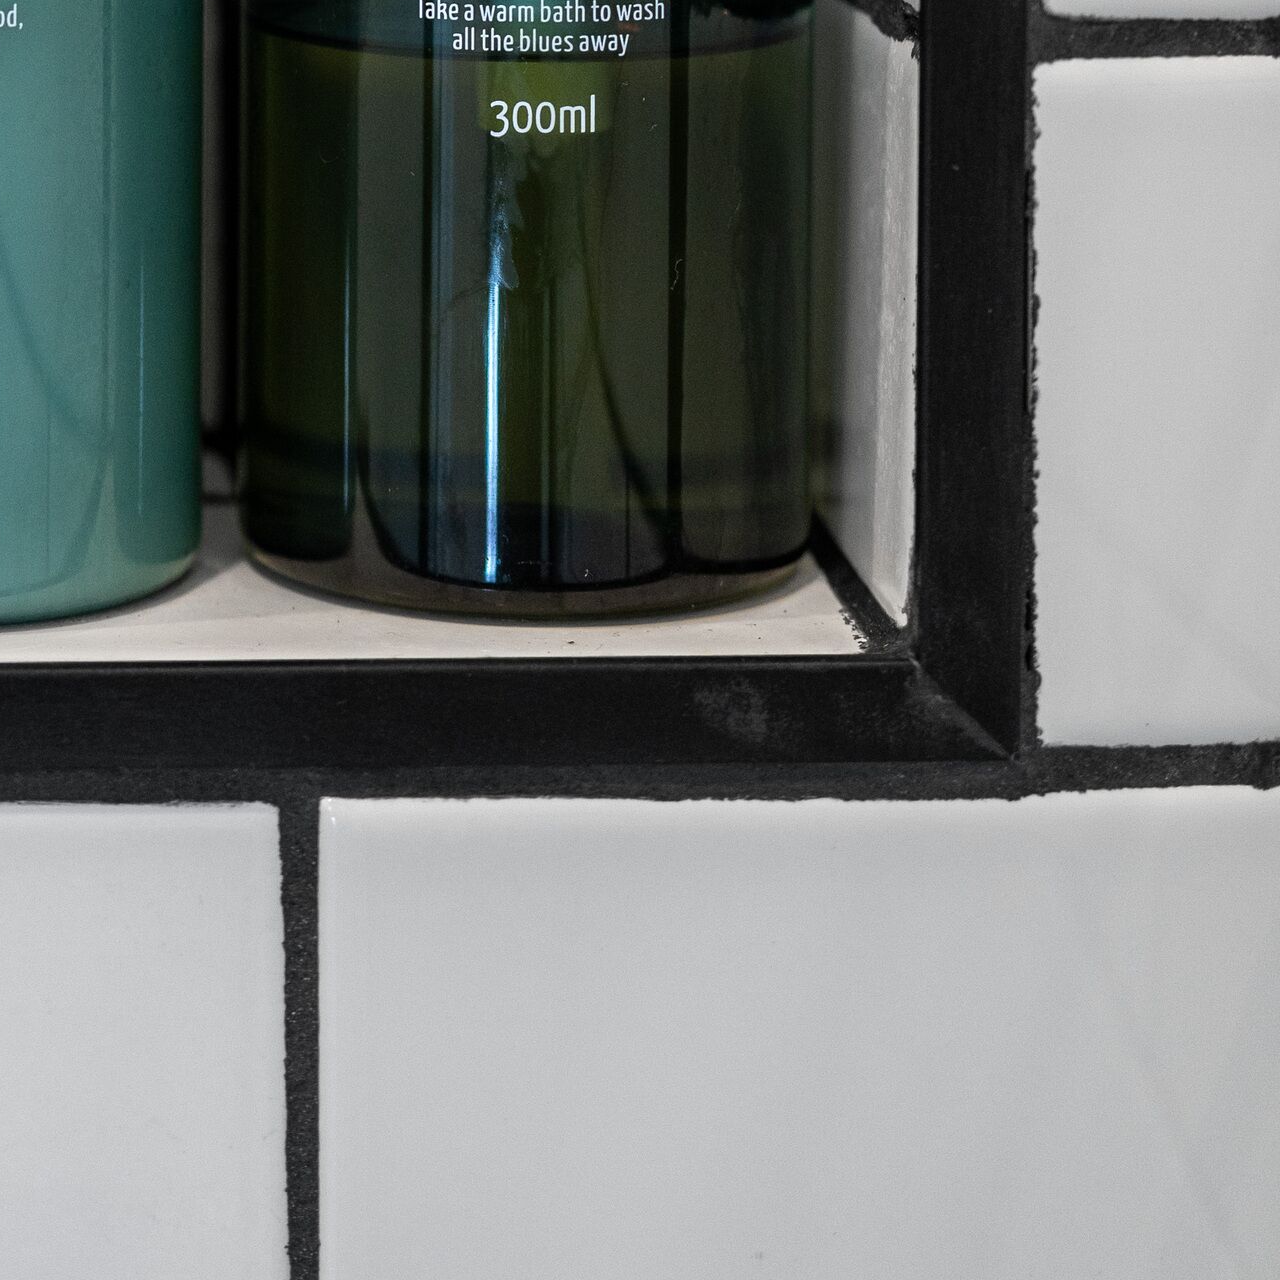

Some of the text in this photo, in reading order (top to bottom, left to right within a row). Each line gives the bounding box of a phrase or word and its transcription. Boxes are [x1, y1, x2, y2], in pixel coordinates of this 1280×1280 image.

[463, 3, 475, 22] a
[479, 3, 535, 23] warm
[590, 0, 612, 23] to
[452, 26, 630, 57] all the blues away
[489, 93, 596, 139] 300ml
